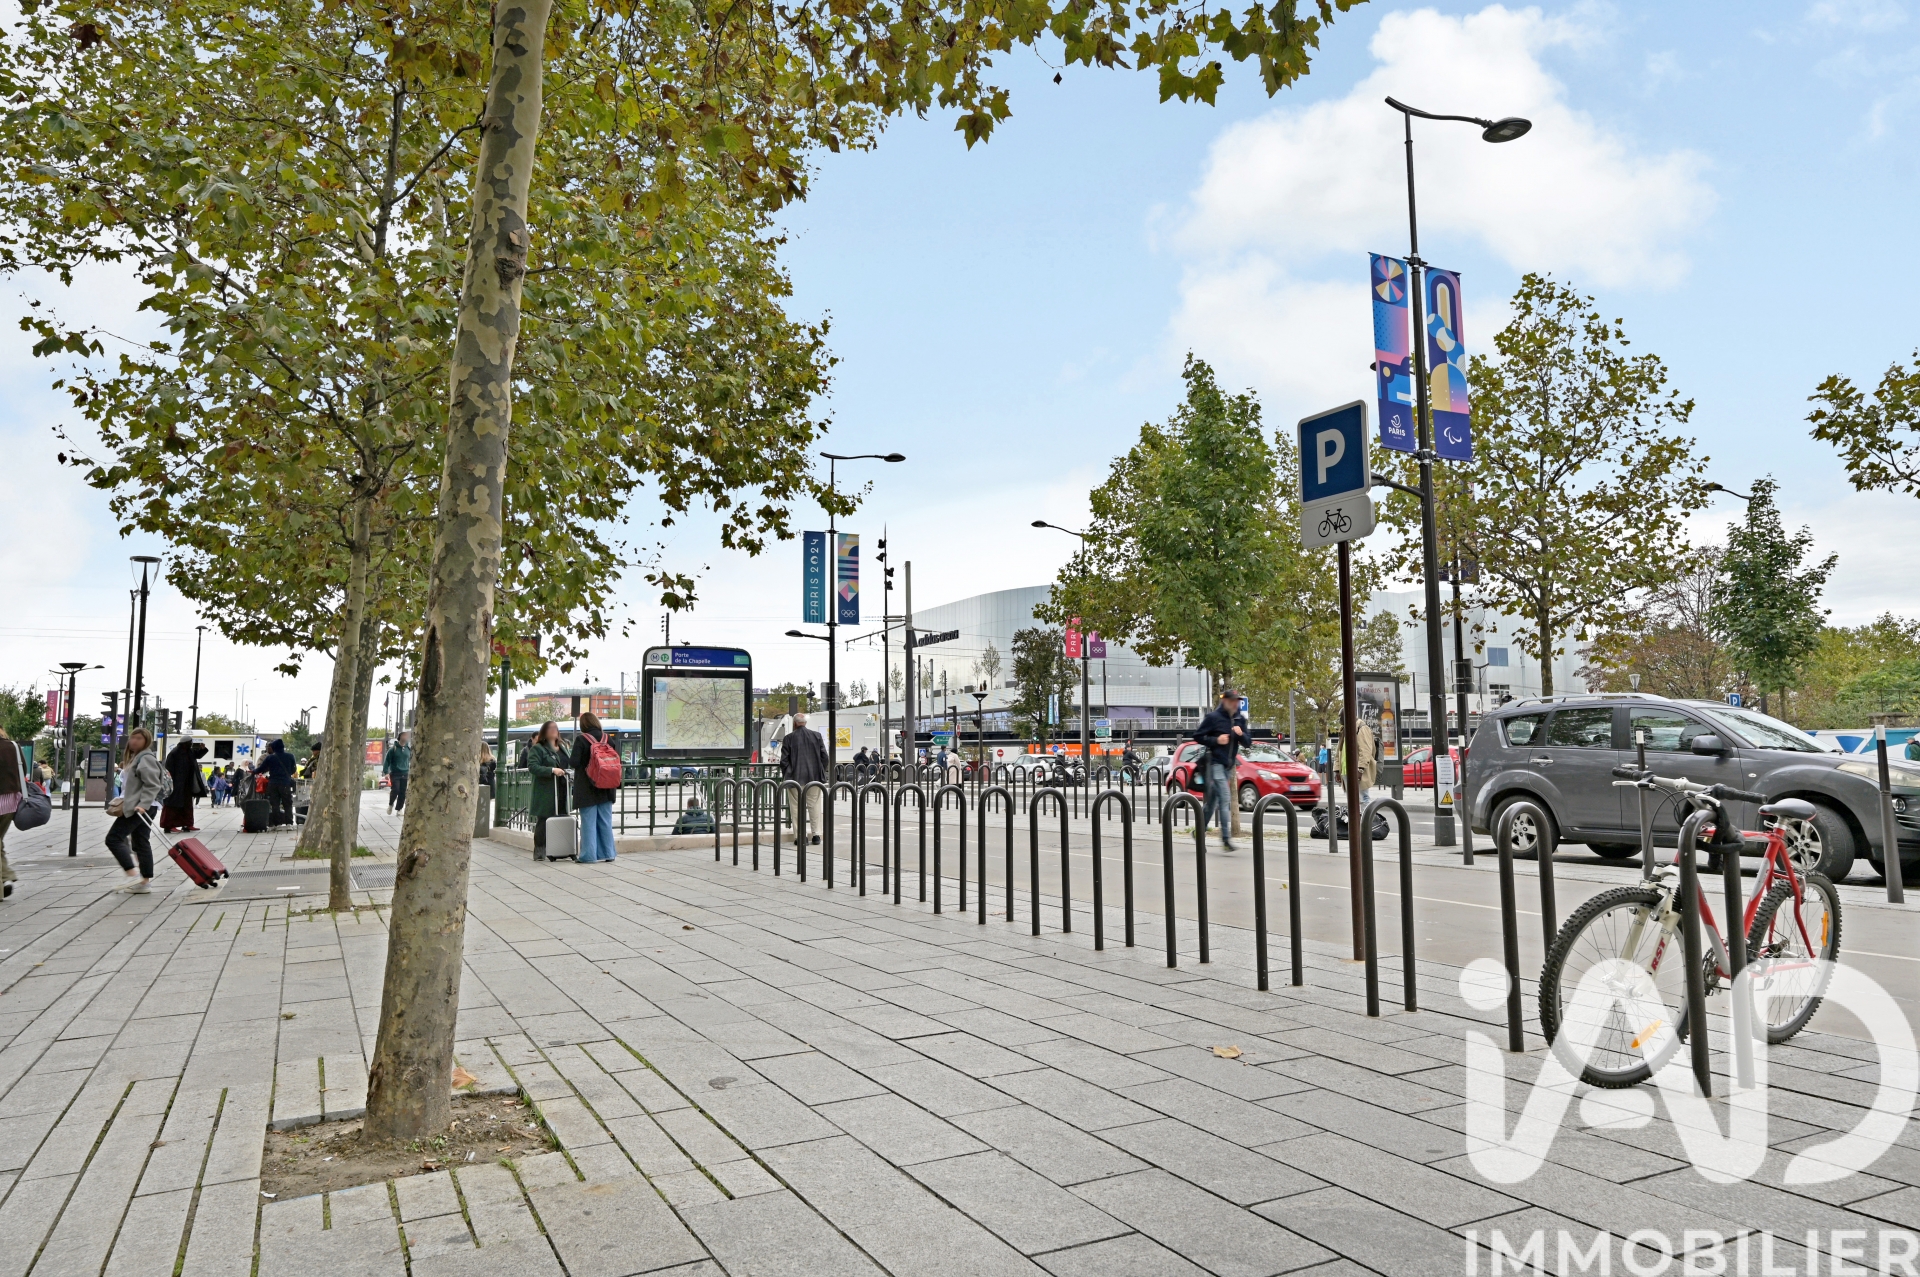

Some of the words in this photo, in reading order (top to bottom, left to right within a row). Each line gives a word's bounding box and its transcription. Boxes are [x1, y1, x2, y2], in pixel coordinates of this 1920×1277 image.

[1388, 426, 1406, 437] PARIS
[1316, 428, 1345, 485] P
[810, 538, 819, 573] 2024
[810, 578, 819, 616] PARIS
[1732, 696, 1738, 706] P
[1135, 751, 1150, 760] SUD
[1651, 936, 1666, 971] RST
